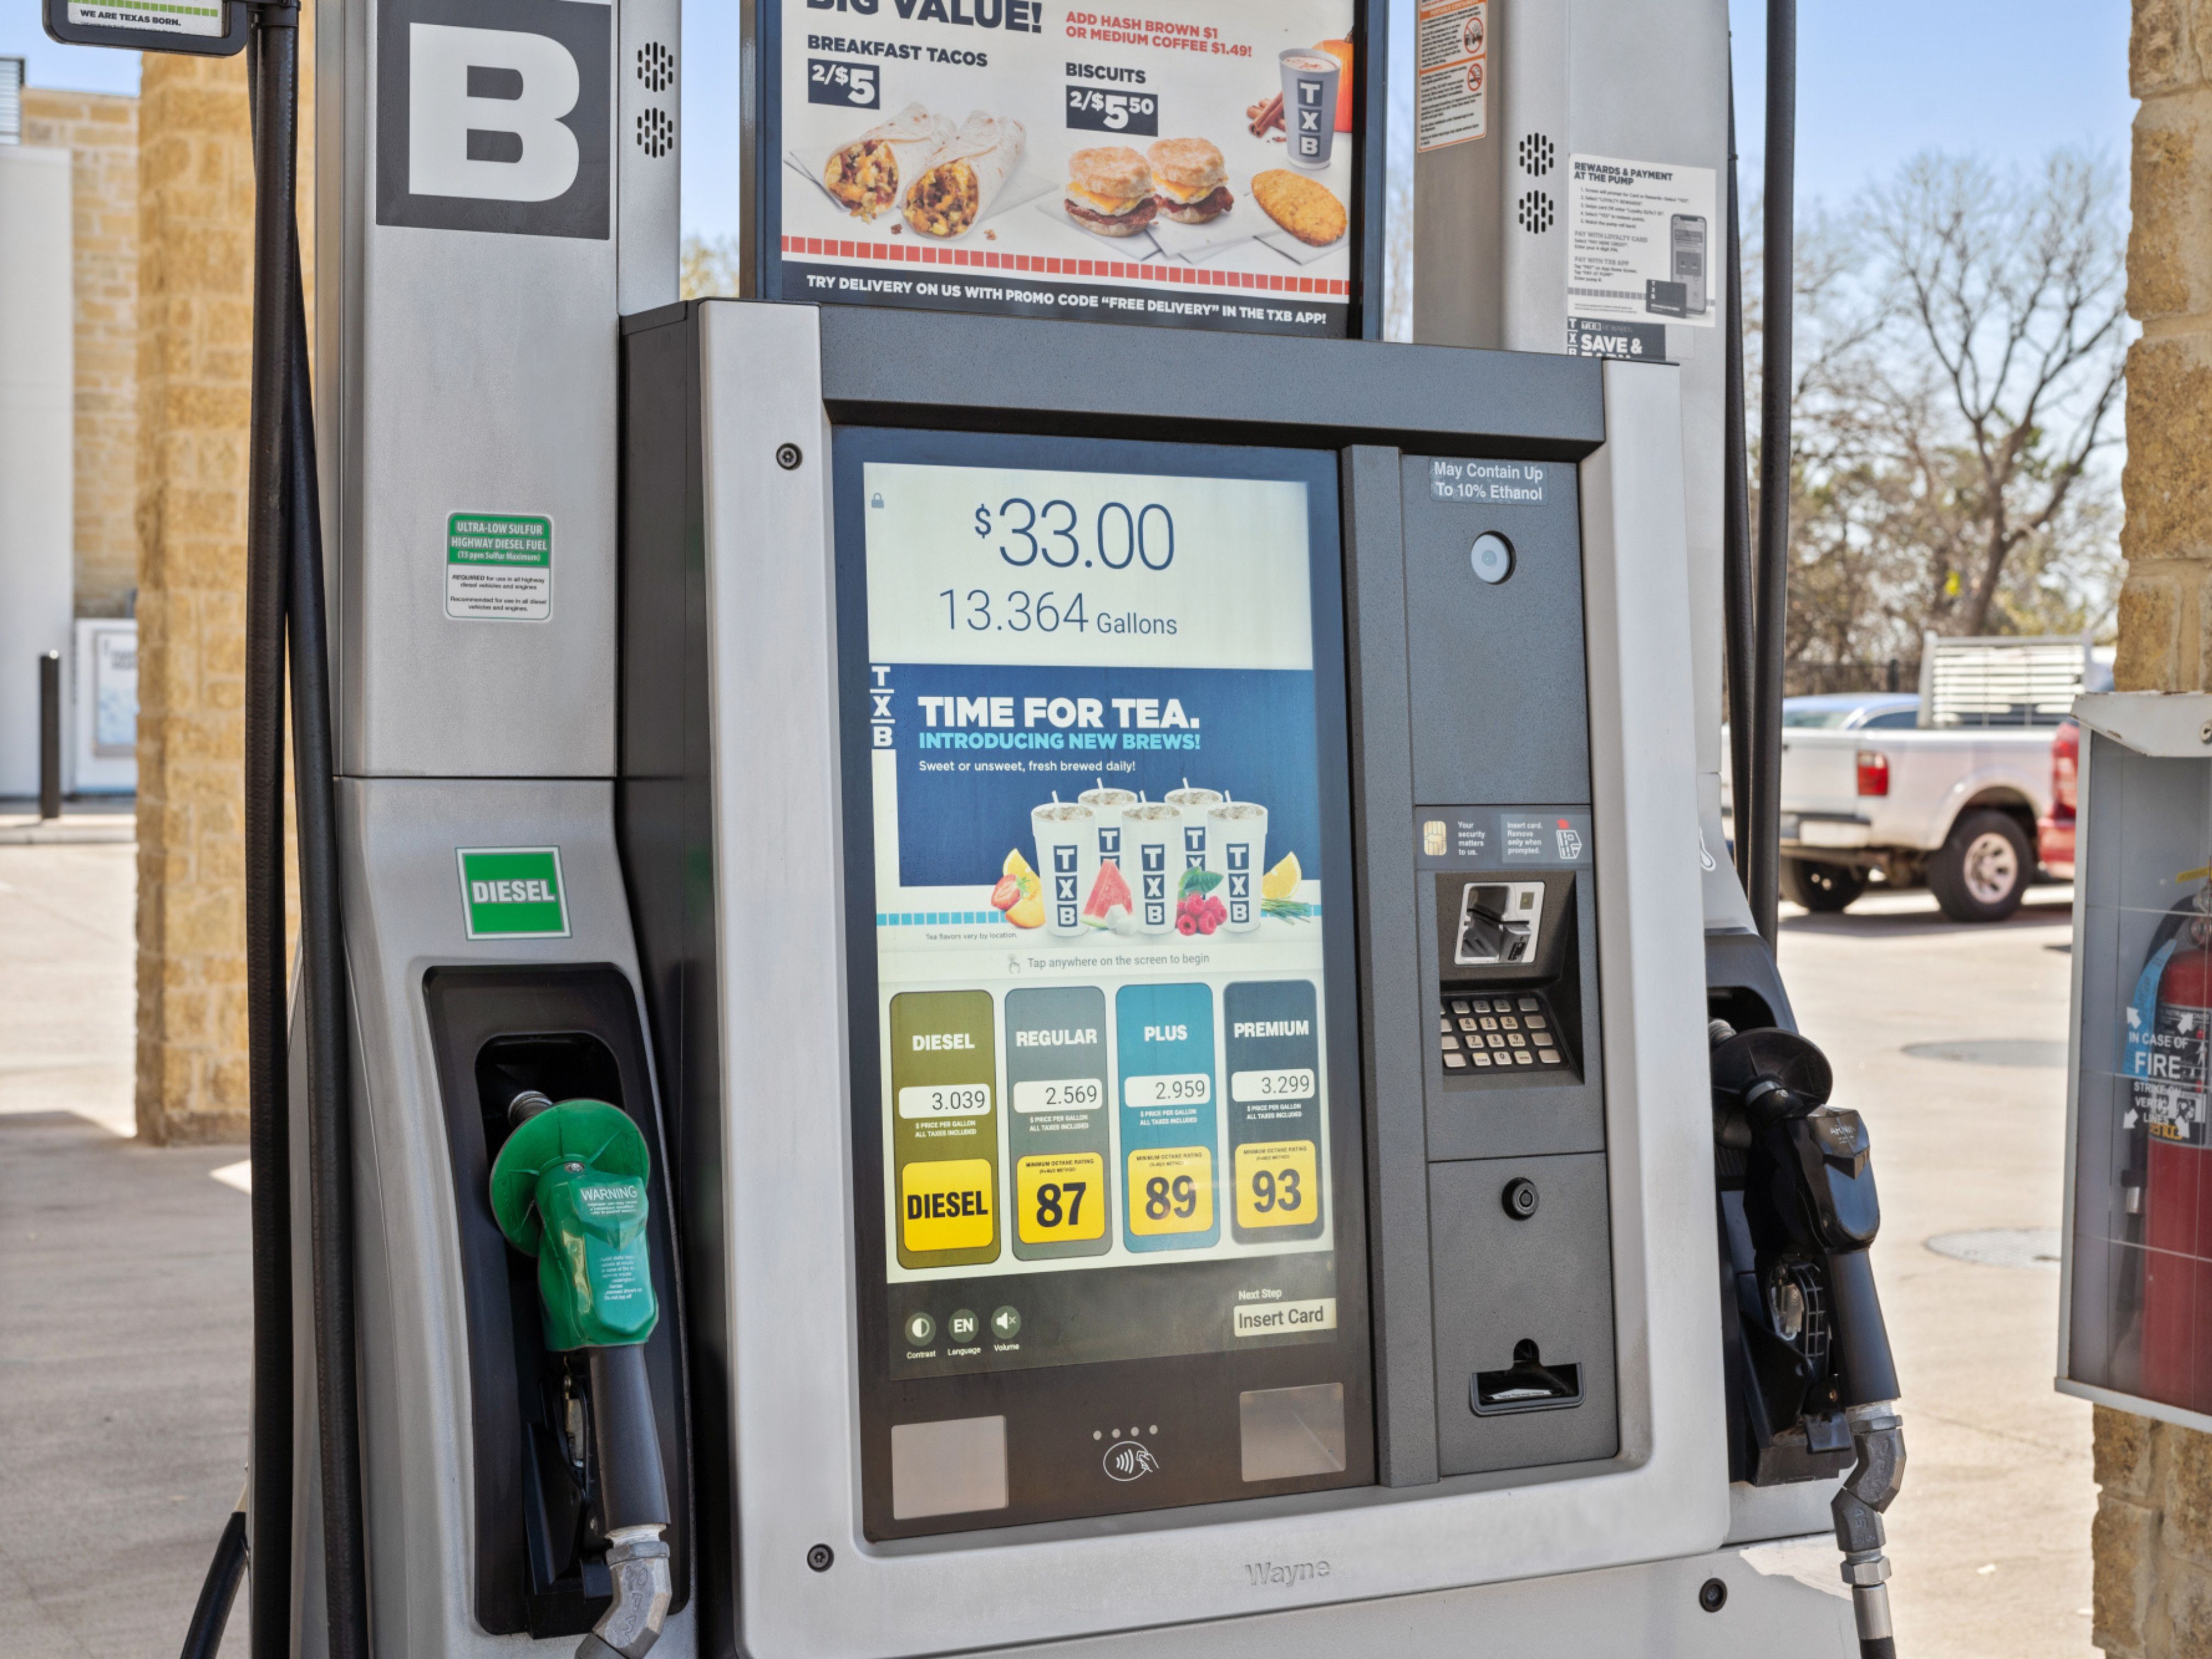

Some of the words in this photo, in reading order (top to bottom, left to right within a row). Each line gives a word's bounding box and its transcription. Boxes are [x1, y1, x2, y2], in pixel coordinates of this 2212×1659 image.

[98, 12, 117, 20] ARE
[119, 13, 150, 22] TEXAS
[153, 17, 180, 26] BORN.
[885, 0, 1042, 33] VALUE!
[1066, 11, 1097, 26] ADD
[1101, 15, 1141, 31] HASH
[1145, 21, 1199, 37] BROWN
[1203, 26, 1218, 40] $1
[808, 35, 922, 60] BREAKFAST
[926, 47, 988, 66] TACOS
[1066, 26, 1086, 39] OR
[1090, 28, 1148, 46] MEDIUM
[1152, 35, 1207, 52] COFFEE
[1211, 42, 1252, 57] $1.49!
[1066, 62, 1146, 83] BISCUITS
[409, 22, 579, 202] B
[1575, 162, 1620, 174] REWARDS
[1630, 168, 1672, 181] PAYMENT
[1589, 173, 1606, 182] THE
[1609, 175, 1634, 185] PUMP
[807, 275, 835, 289] TRY
[839, 278, 913, 294] DELIVERY
[917, 283, 938, 295] ON
[942, 285, 961, 297] US
[965, 286, 1002, 300] WITH
[1006, 290, 1054, 304] PROMO
[1058, 294, 1098, 307] CODE
[1223, 306, 1236, 316] IN
[1239, 307, 1263, 319] THE
[1267, 309, 1292, 321] TXB
[1296, 312, 1326, 324] APP!
[1581, 334, 1628, 353] SAVE
[1630, 338, 1642, 354] &
[1434, 461, 1462, 479] May
[1467, 463, 1520, 479] Contain
[1525, 466, 1543, 483] Up
[1437, 481, 1453, 496] To
[1458, 483, 1486, 498] 10%
[1491, 485, 1542, 500] Ethanol
[457, 522, 506, 534] ULTRA-LOW
[509, 524, 542, 535] SULFUR
[974, 498, 1175, 571] $33.00
[452, 537, 493, 548] HIGHWAY
[495, 539, 523, 549] DIESEL
[526, 540, 546, 550] FUEL
[458, 551, 469, 559] (15
[506, 553, 541, 562] Maximum)
[939, 589, 1088, 633] 13.364
[1097, 612, 1177, 635] Gallons
[918, 696, 1014, 727] TIME
[1024, 697, 1103, 728] FOR
[1111, 699, 1200, 729] TEA.
[919, 733, 1064, 749] INTRODUCING
[1069, 733, 1116, 749] NEW
[1122, 734, 1200, 750] BREWS!
[919, 760, 955, 771] Sweet
[958, 762, 970, 771] or
[975, 761, 1025, 772] unsweet,
[1029, 761, 1057, 771] fresh
[1060, 761, 1102, 771] brewed
[1106, 761, 1136, 773] daily!
[1458, 831, 1485, 839] security
[472, 881, 555, 902] DIESEL
[1028, 958, 1046, 969] Tap
[1049, 956, 1097, 969] anywhere
[1115, 956, 1131, 965] the
[1135, 956, 1167, 965] screen
[1171, 955, 1180, 964] to
[1183, 953, 1210, 966] begin
[1016, 1029, 1097, 1047] REGULAR
[1144, 1025, 1187, 1041] PLUS
[1234, 1021, 1309, 1038] PREMIUM
[912, 1033, 975, 1051] DIESEL
[2129, 1031, 2139, 1043] IN
[2142, 1032, 2171, 1047] CASE
[2174, 1037, 2189, 1049] OF
[2135, 1051, 2181, 1079] FIRE
[1156, 1080, 1205, 1099] 2.959
[1262, 1075, 1309, 1094] 3.299
[932, 1091, 985, 1110] 3.039
[1046, 1085, 1097, 1104] 2.569
[580, 1186, 637, 1200] WARNING
[1146, 1175, 1197, 1220] 89
[1252, 1169, 1301, 1213] 93
[907, 1191, 988, 1220] DIESEL
[1037, 1182, 1086, 1227] 87
[1239, 1290, 1260, 1300] Next
[1262, 1289, 1282, 1299] Step
[954, 1318, 973, 1333] EN
[1239, 1311, 1284, 1328] Insert
[1288, 1305, 1324, 1324] Card
[907, 1350, 936, 1359] Contrast
[947, 1346, 981, 1356] Language
[994, 1344, 1019, 1352] Volume
[1245, 1560, 1330, 1587] Wayne
